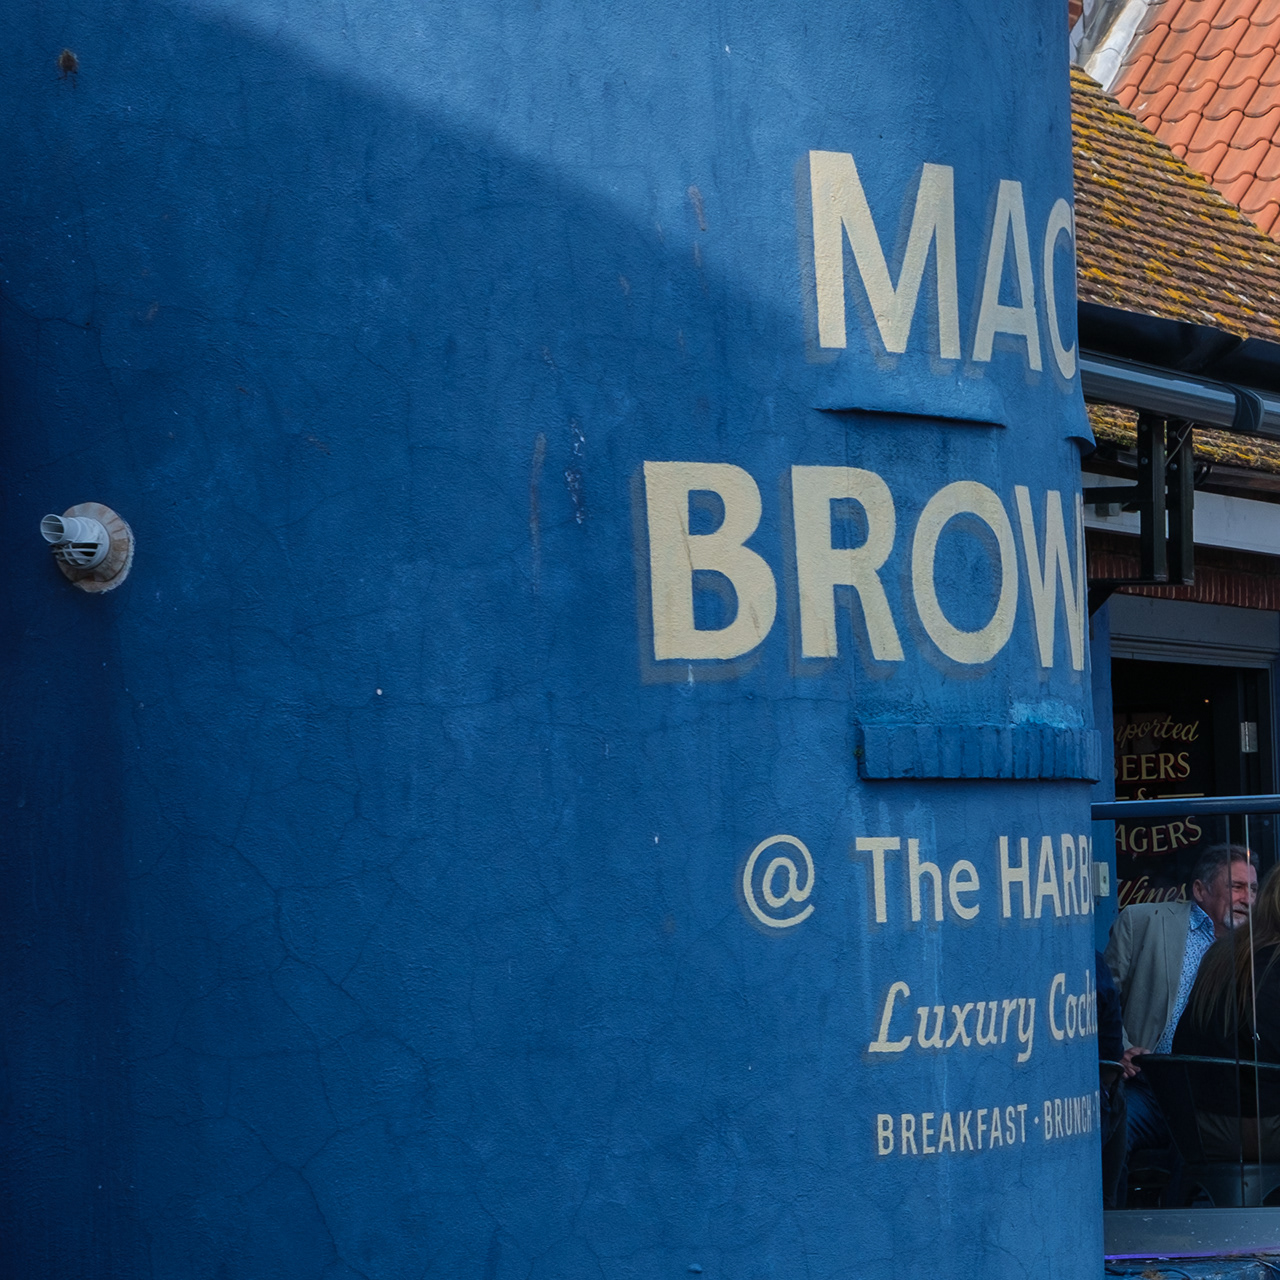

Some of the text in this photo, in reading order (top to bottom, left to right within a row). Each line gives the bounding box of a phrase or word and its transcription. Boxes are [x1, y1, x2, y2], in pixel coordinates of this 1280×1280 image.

[743, 834, 815, 928] @
[855, 836, 981, 923] The
[868, 981, 1036, 1063] Luxury
[877, 1104, 1027, 1155] BREAKFAST
[1044, 1094, 1093, 1141] BRUNCH
